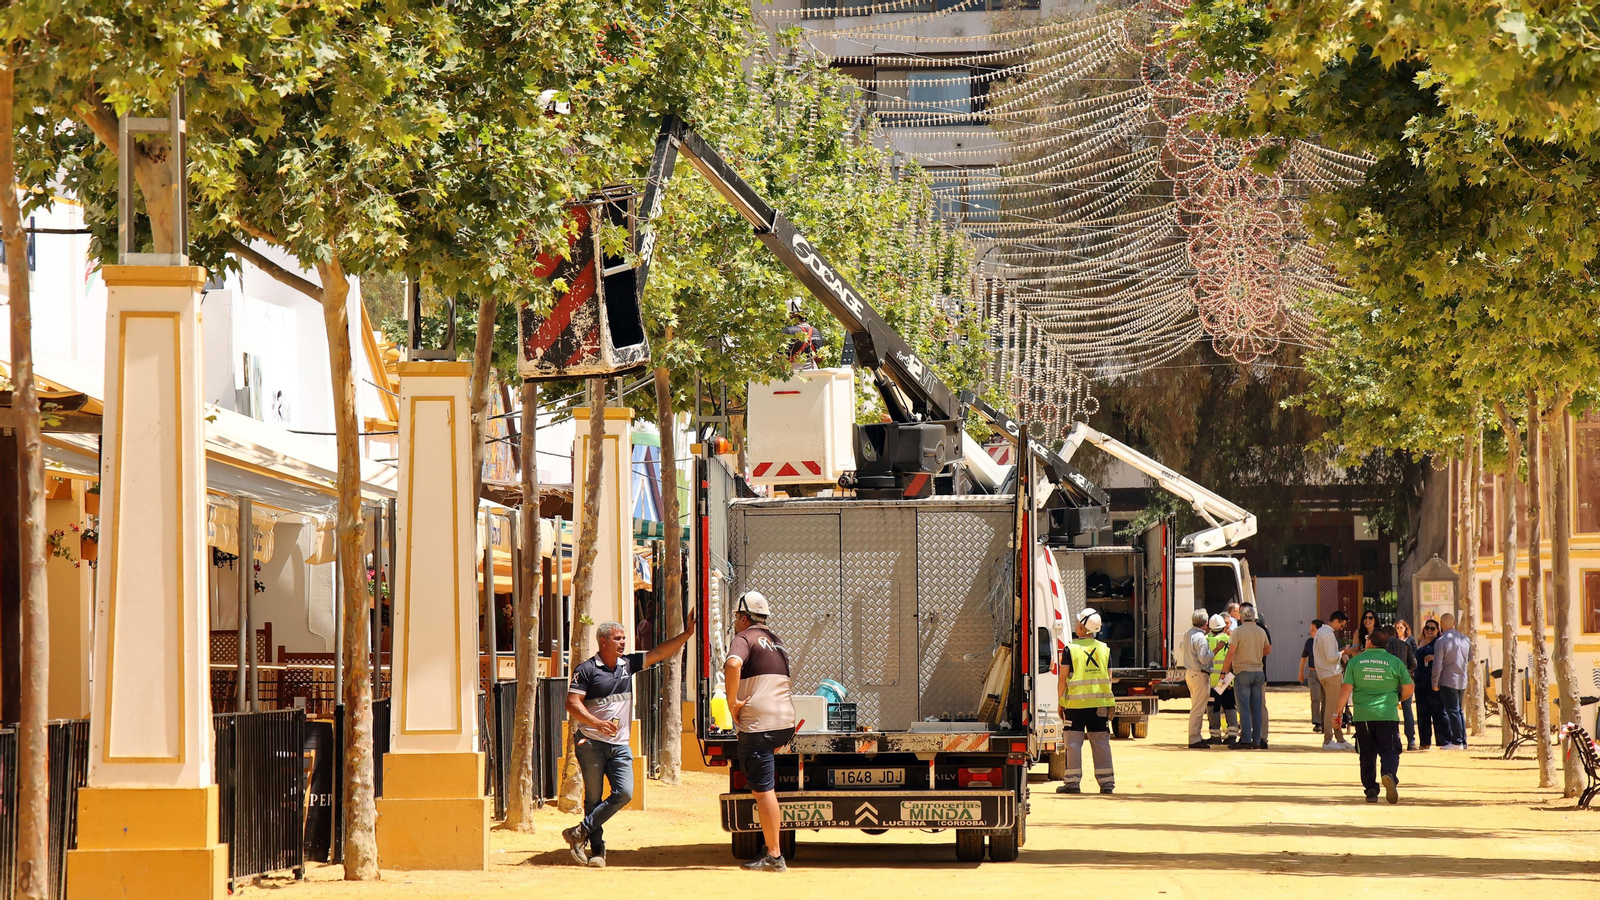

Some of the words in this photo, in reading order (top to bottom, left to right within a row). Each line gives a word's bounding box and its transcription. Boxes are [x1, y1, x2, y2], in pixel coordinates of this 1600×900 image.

[792, 233, 864, 321] SOCAGE
[1005, 420, 1049, 459] SAGE
[841, 771, 872, 784] 1648
[878, 770, 903, 783] JDJ
[753, 802, 832, 810] Crocerias
[901, 800, 982, 810] Carrocerias
[909, 808, 974, 820] MINDA
[937, 819, 988, 827] (CORDOBA)
